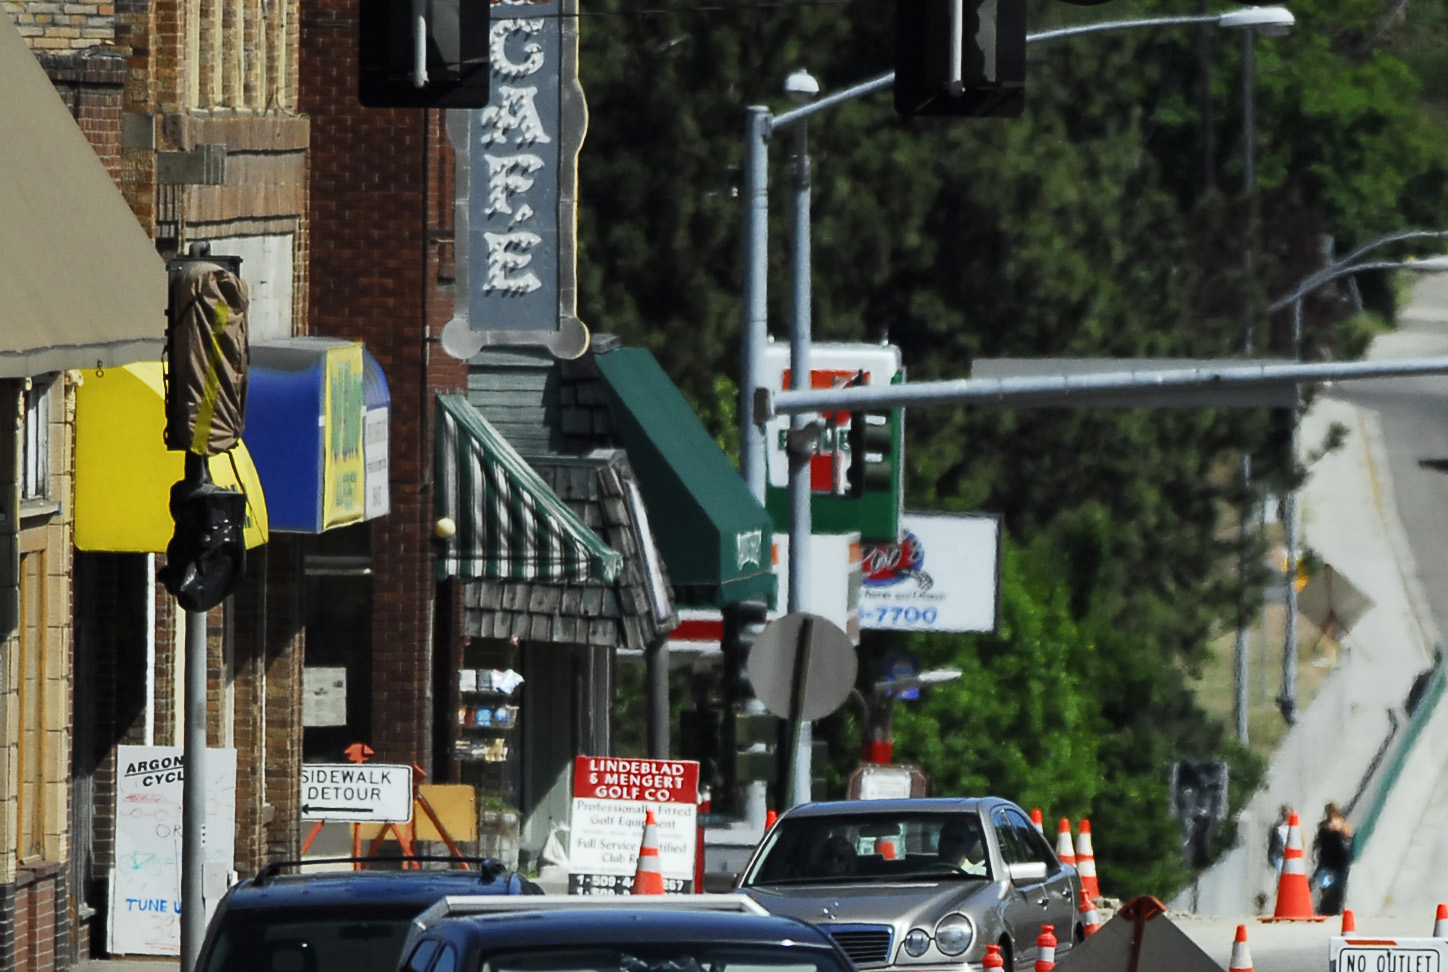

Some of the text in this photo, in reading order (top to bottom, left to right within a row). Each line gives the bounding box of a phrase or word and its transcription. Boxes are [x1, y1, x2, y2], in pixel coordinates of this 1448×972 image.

[588, 759, 685, 776] LINDEBLAD
[142, 771, 184, 787] CYCL
[302, 769, 392, 785] SIDEWALK
[604, 773, 685, 789] MENGERT
[307, 786, 382, 801] DETOUR
[594, 785, 676, 802] GOLF CO.
[658, 805, 692, 816] Fitted
[600, 840, 637, 851] Service
[126, 898, 168, 913] TUNE
[1347, 954, 1367, 972] NO
